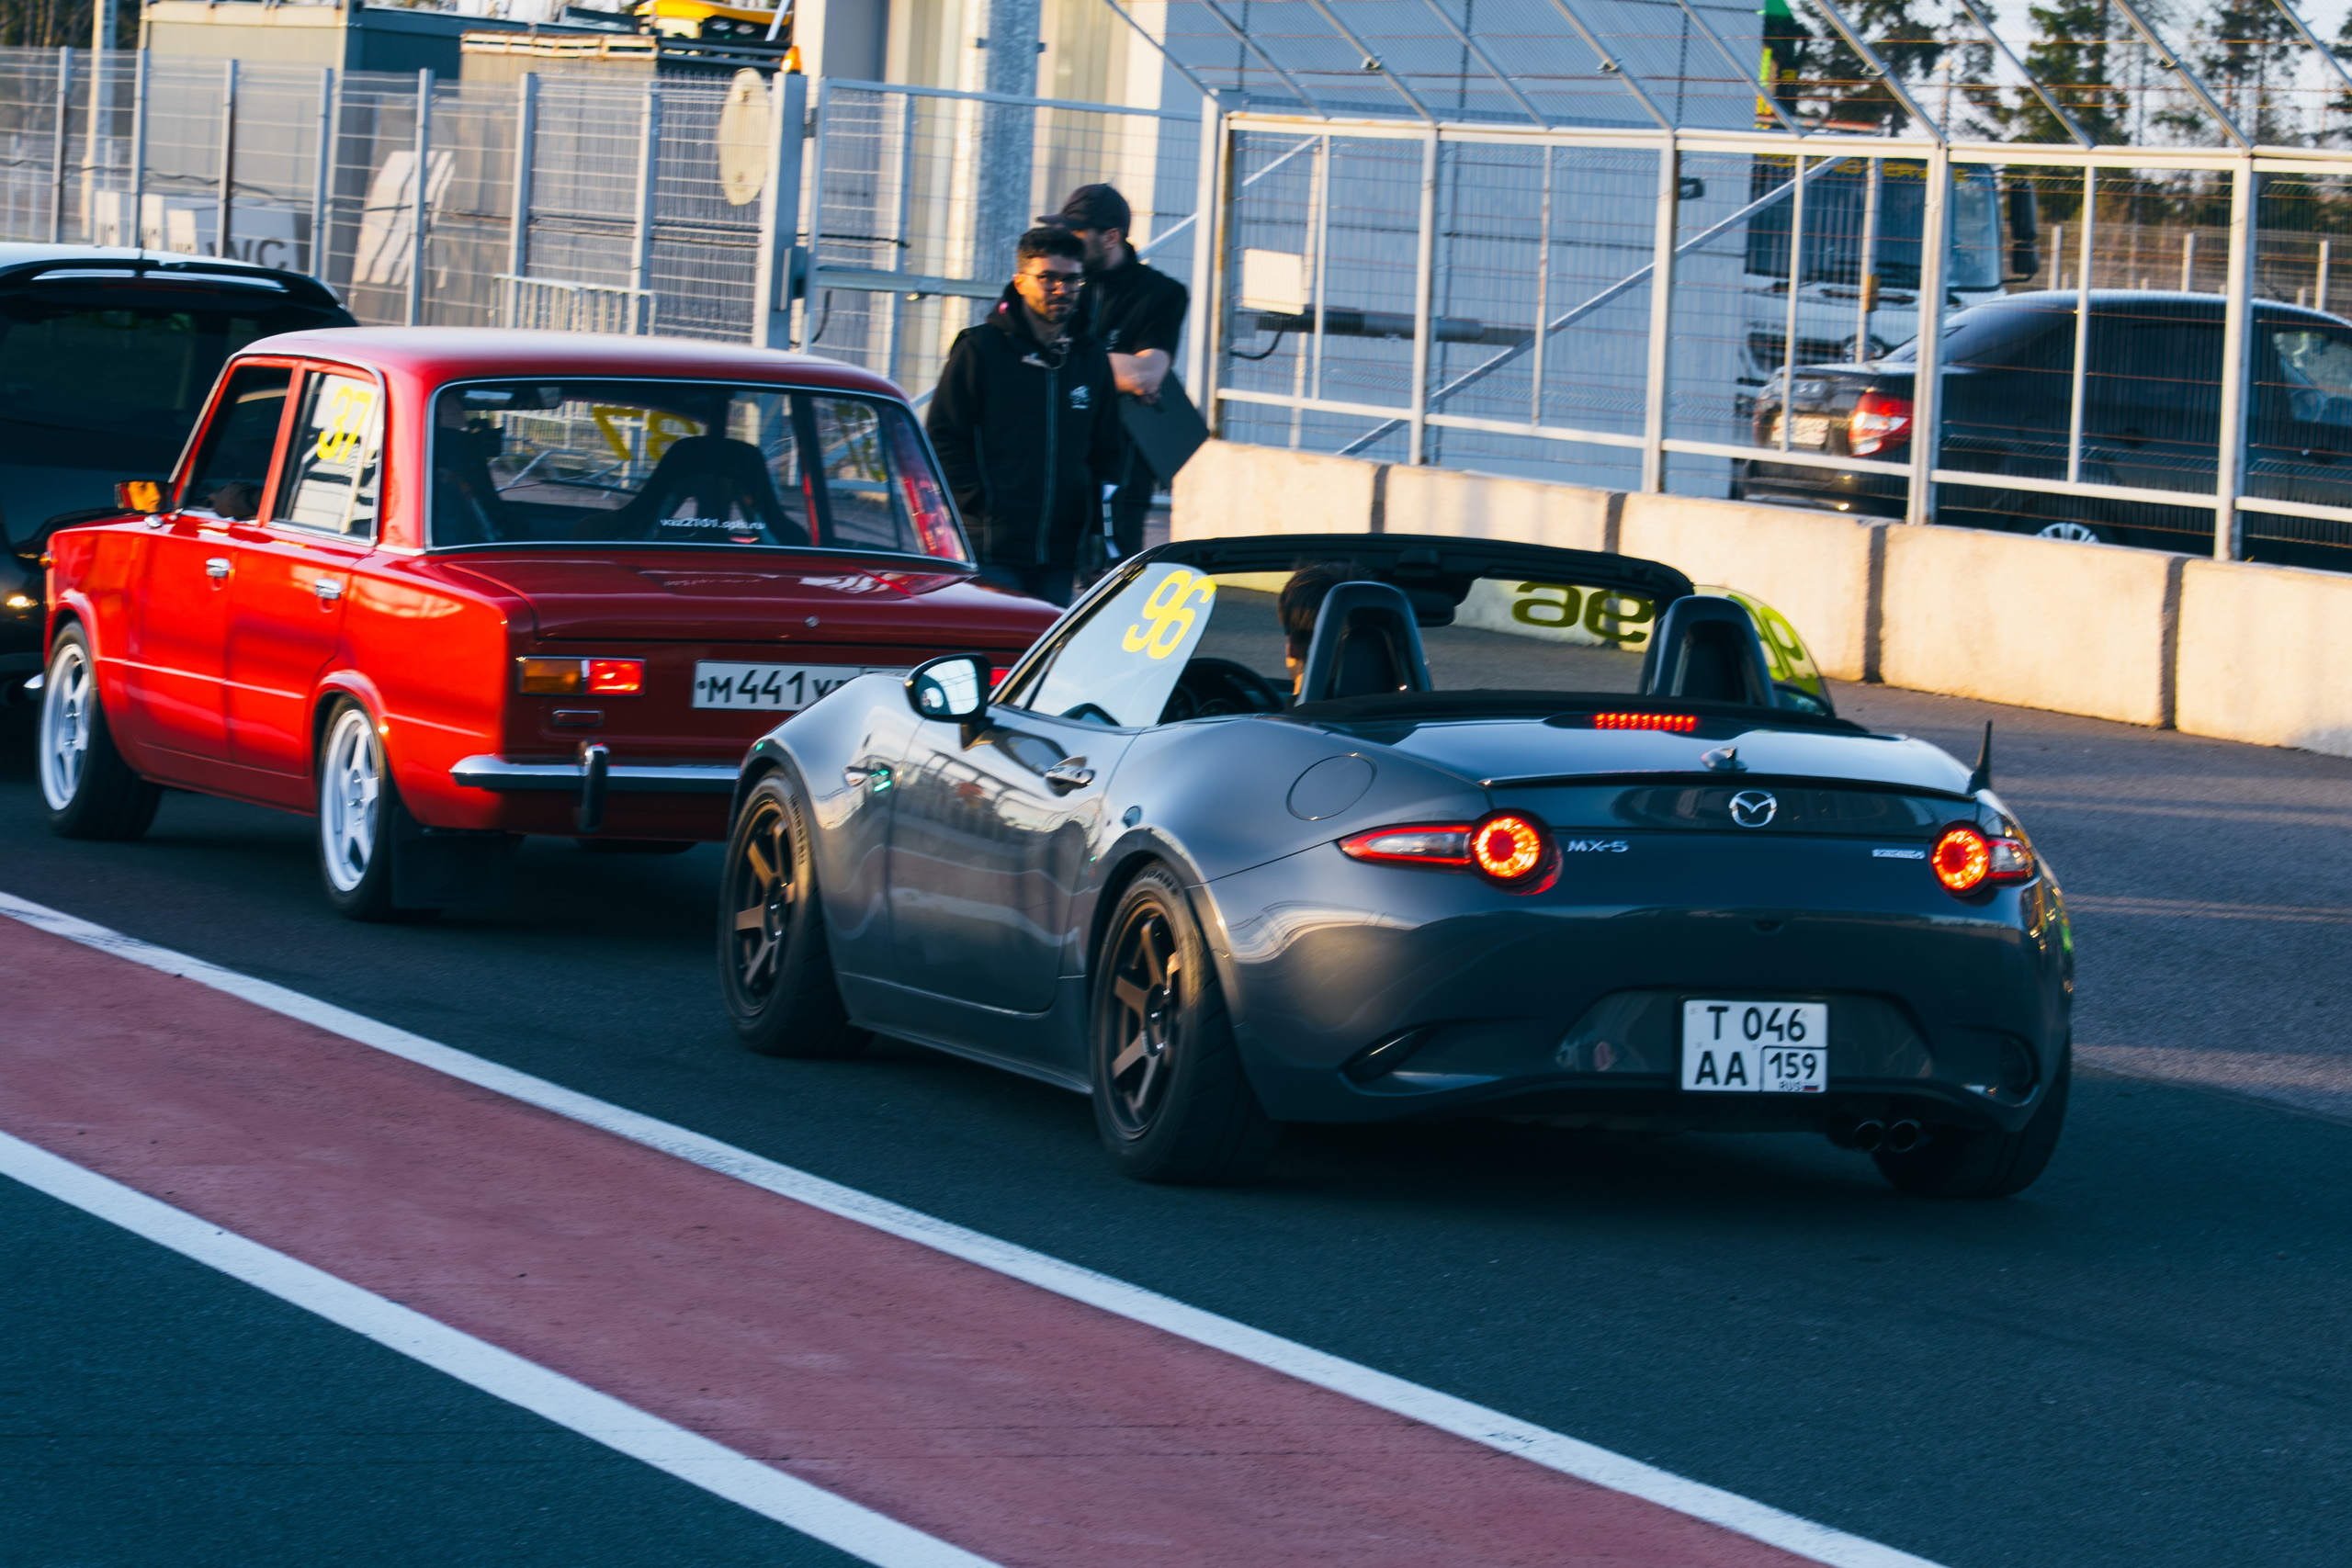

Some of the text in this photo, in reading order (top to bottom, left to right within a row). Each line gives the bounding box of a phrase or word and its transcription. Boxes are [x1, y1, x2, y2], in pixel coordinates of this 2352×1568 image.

[208, 237, 288, 271] WC
[316, 385, 372, 464] 37
[1122, 570, 1216, 660] 96
[1566, 839, 1629, 852] MX-5
[1706, 1005, 1805, 1042] T 046
[1694, 1050, 1816, 1086] AA 159
[1779, 1080, 1802, 1091] RUS
